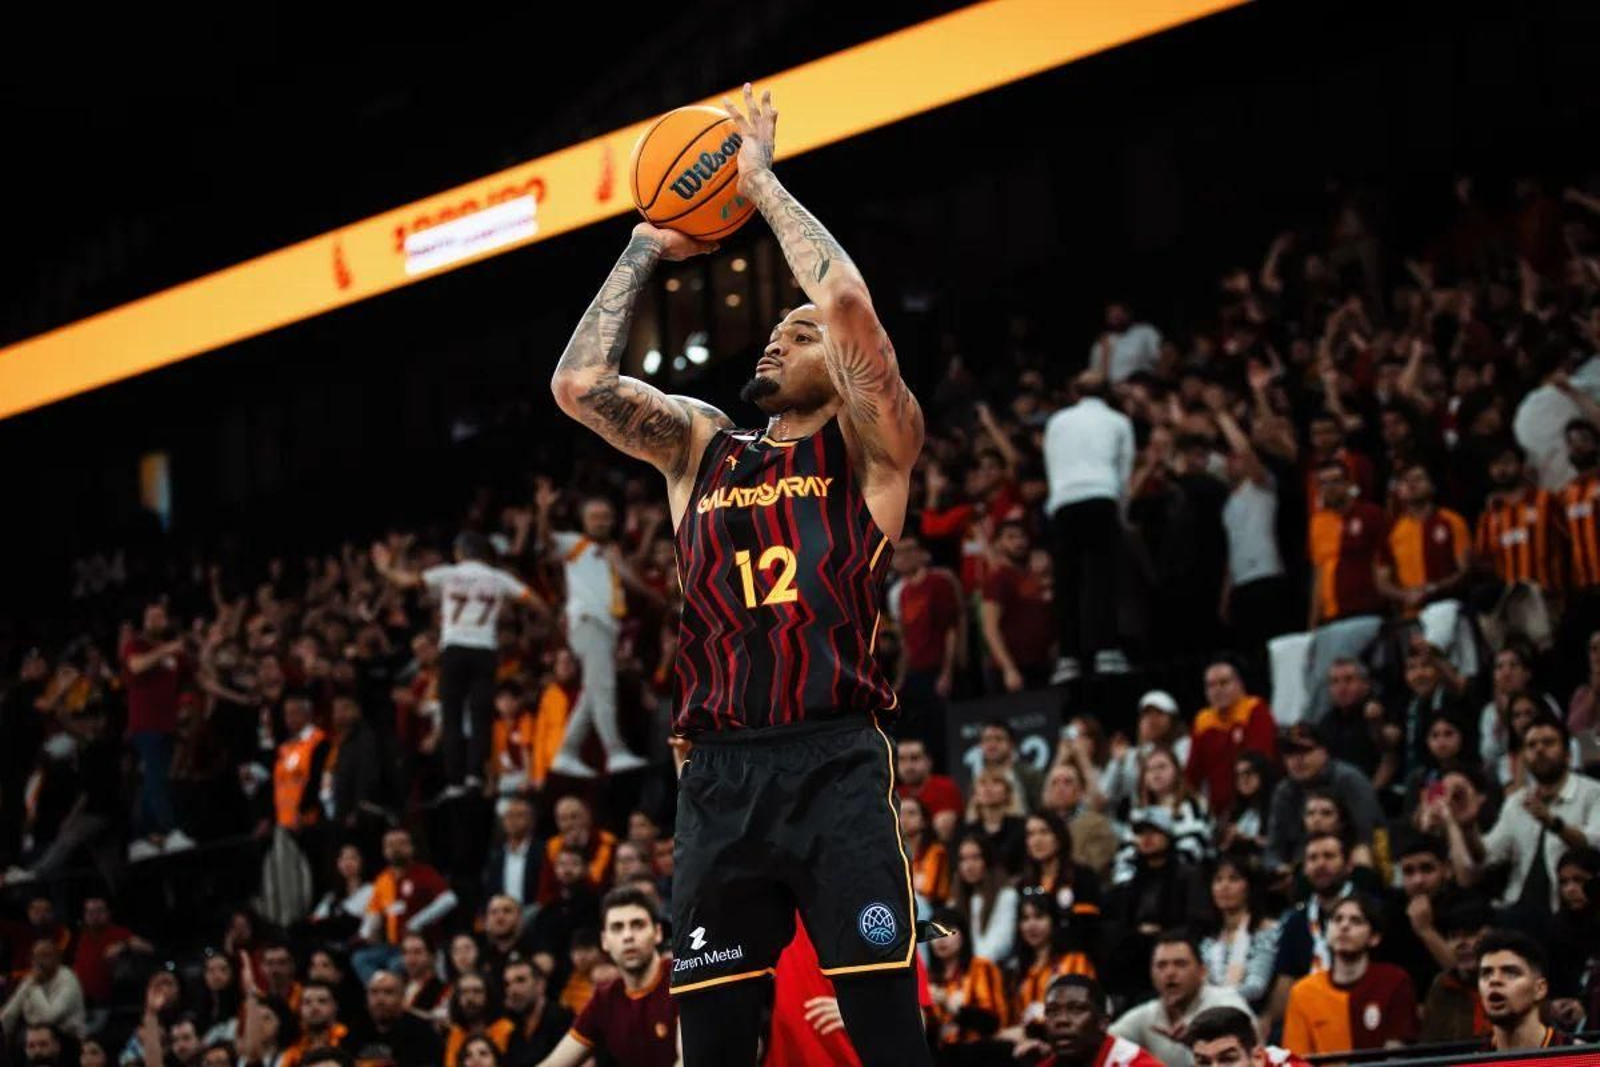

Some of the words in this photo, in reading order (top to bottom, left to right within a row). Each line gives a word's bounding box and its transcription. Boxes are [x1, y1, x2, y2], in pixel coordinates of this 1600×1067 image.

[670, 132, 743, 199] Wilson
[697, 476, 833, 514] GALATASARAY
[735, 545, 798, 609] 12
[450, 592, 496, 627] 77
[673, 956, 704, 972] Zeren
[704, 944, 744, 965] Metal
